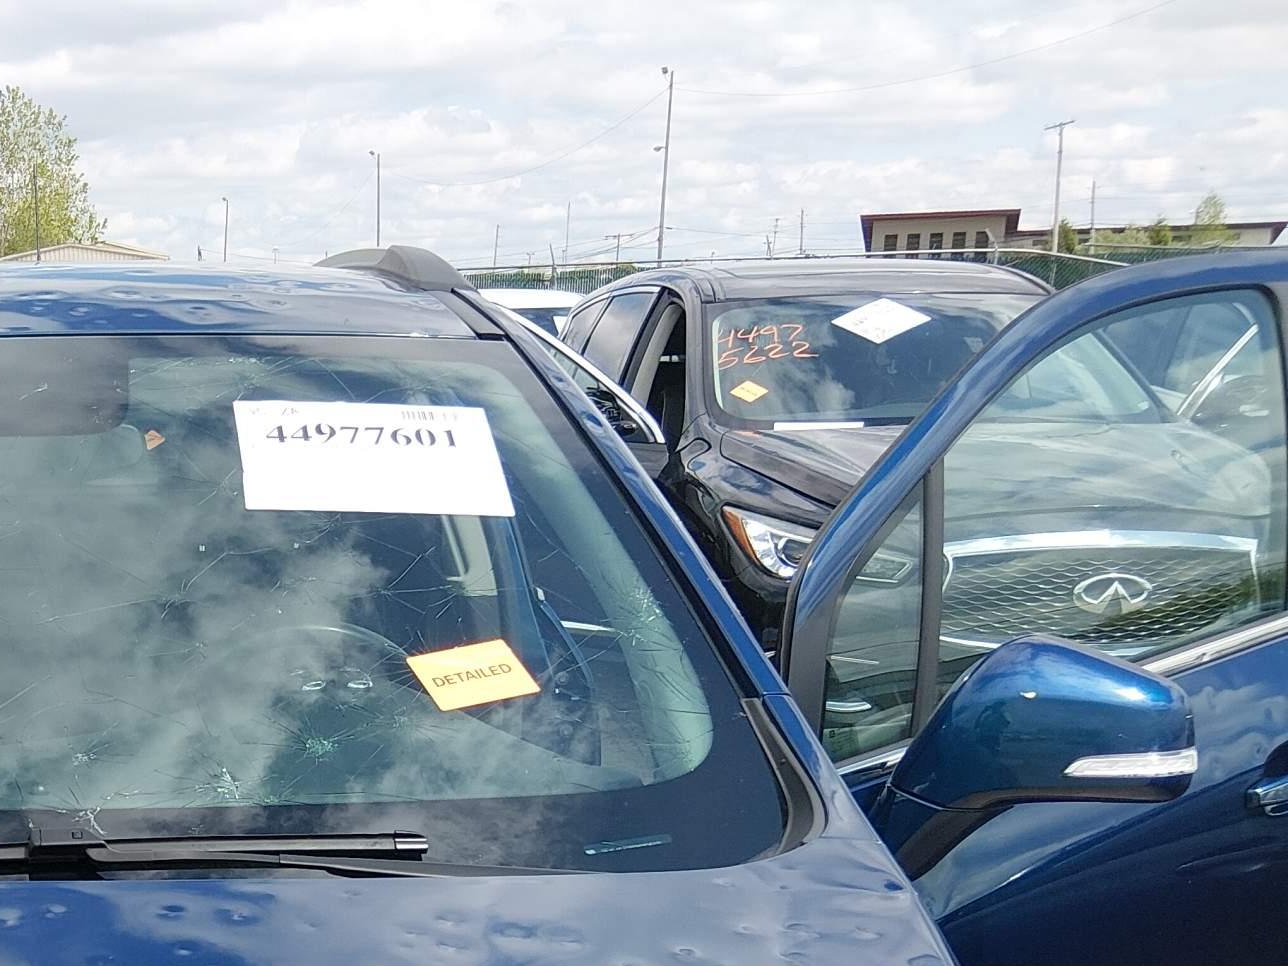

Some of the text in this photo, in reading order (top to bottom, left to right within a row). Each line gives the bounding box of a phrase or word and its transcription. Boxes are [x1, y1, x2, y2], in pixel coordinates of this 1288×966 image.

[716, 324, 804, 349] 4497
[717, 341, 820, 371] 5622
[265, 422, 457, 448] 44977601
[432, 663, 513, 688] DETAILED
